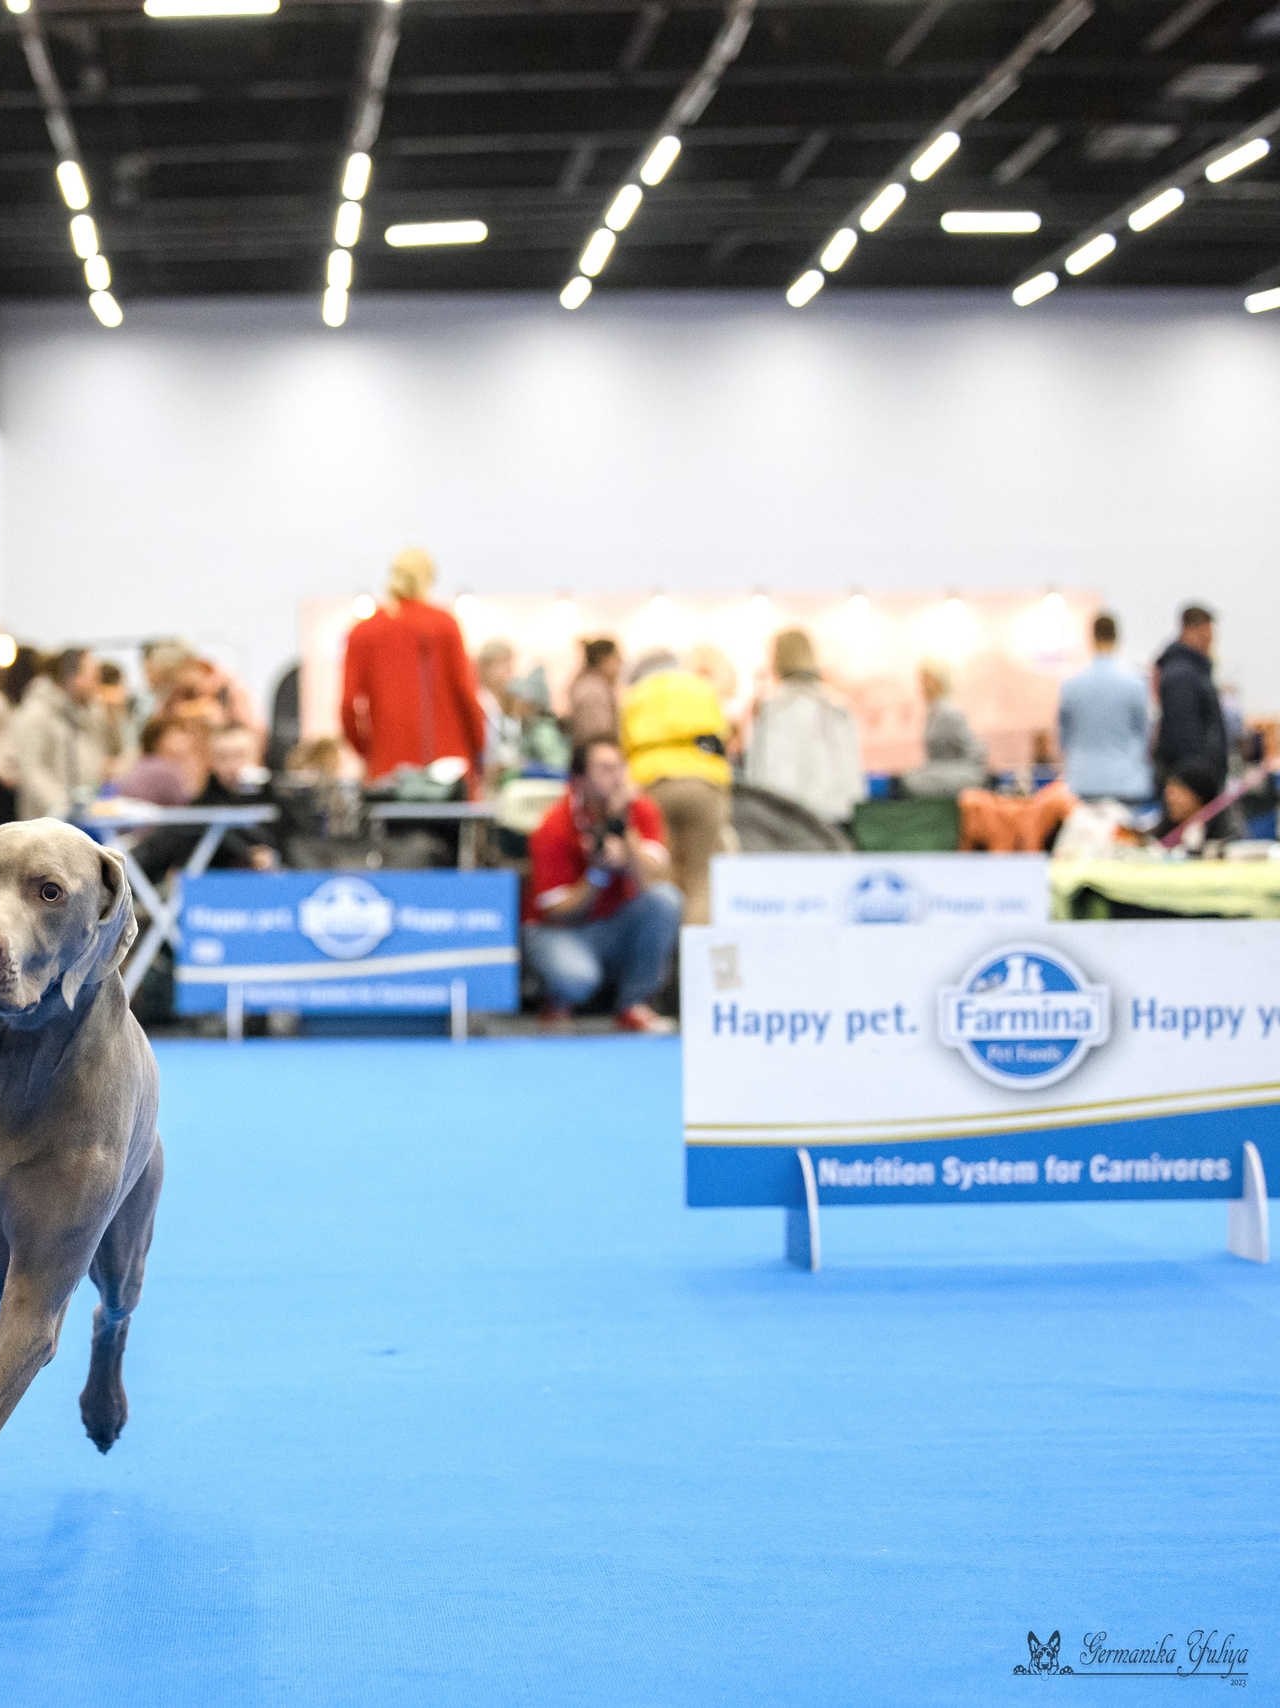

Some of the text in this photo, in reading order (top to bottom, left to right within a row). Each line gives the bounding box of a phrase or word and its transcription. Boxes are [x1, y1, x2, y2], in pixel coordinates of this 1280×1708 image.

[712, 1003, 918, 1043] Happy pet.
[956, 999, 1092, 1032] Farmina
[1132, 996, 1280, 1040] Happy y
[819, 1152, 1233, 1191] Nutrition System for Carnivores
